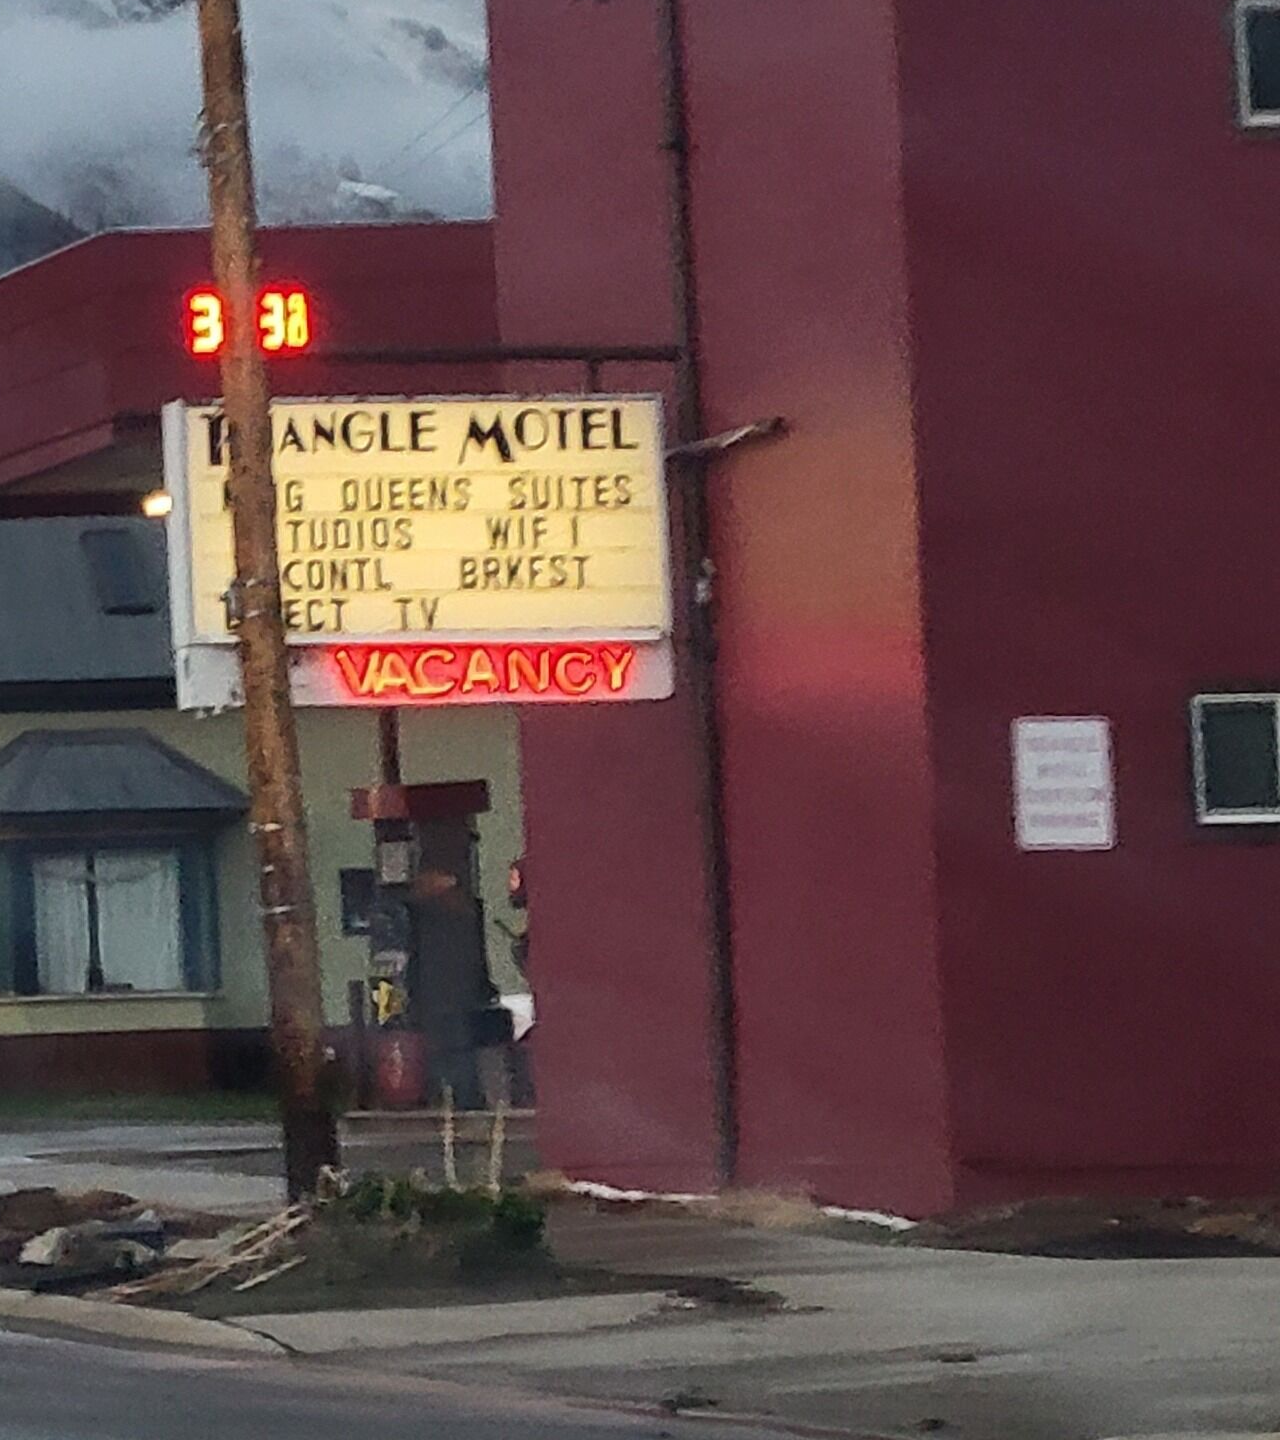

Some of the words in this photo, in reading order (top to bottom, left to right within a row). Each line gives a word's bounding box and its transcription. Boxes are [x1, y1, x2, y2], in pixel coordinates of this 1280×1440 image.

[201, 410, 437, 466] TANGLE
[460, 408, 640, 464] MOTEL
[507, 474, 632, 510] SUITES
[280, 517, 413, 553] TUDIOS
[394, 596, 440, 631] TV
[336, 647, 632, 695] VACANCY
